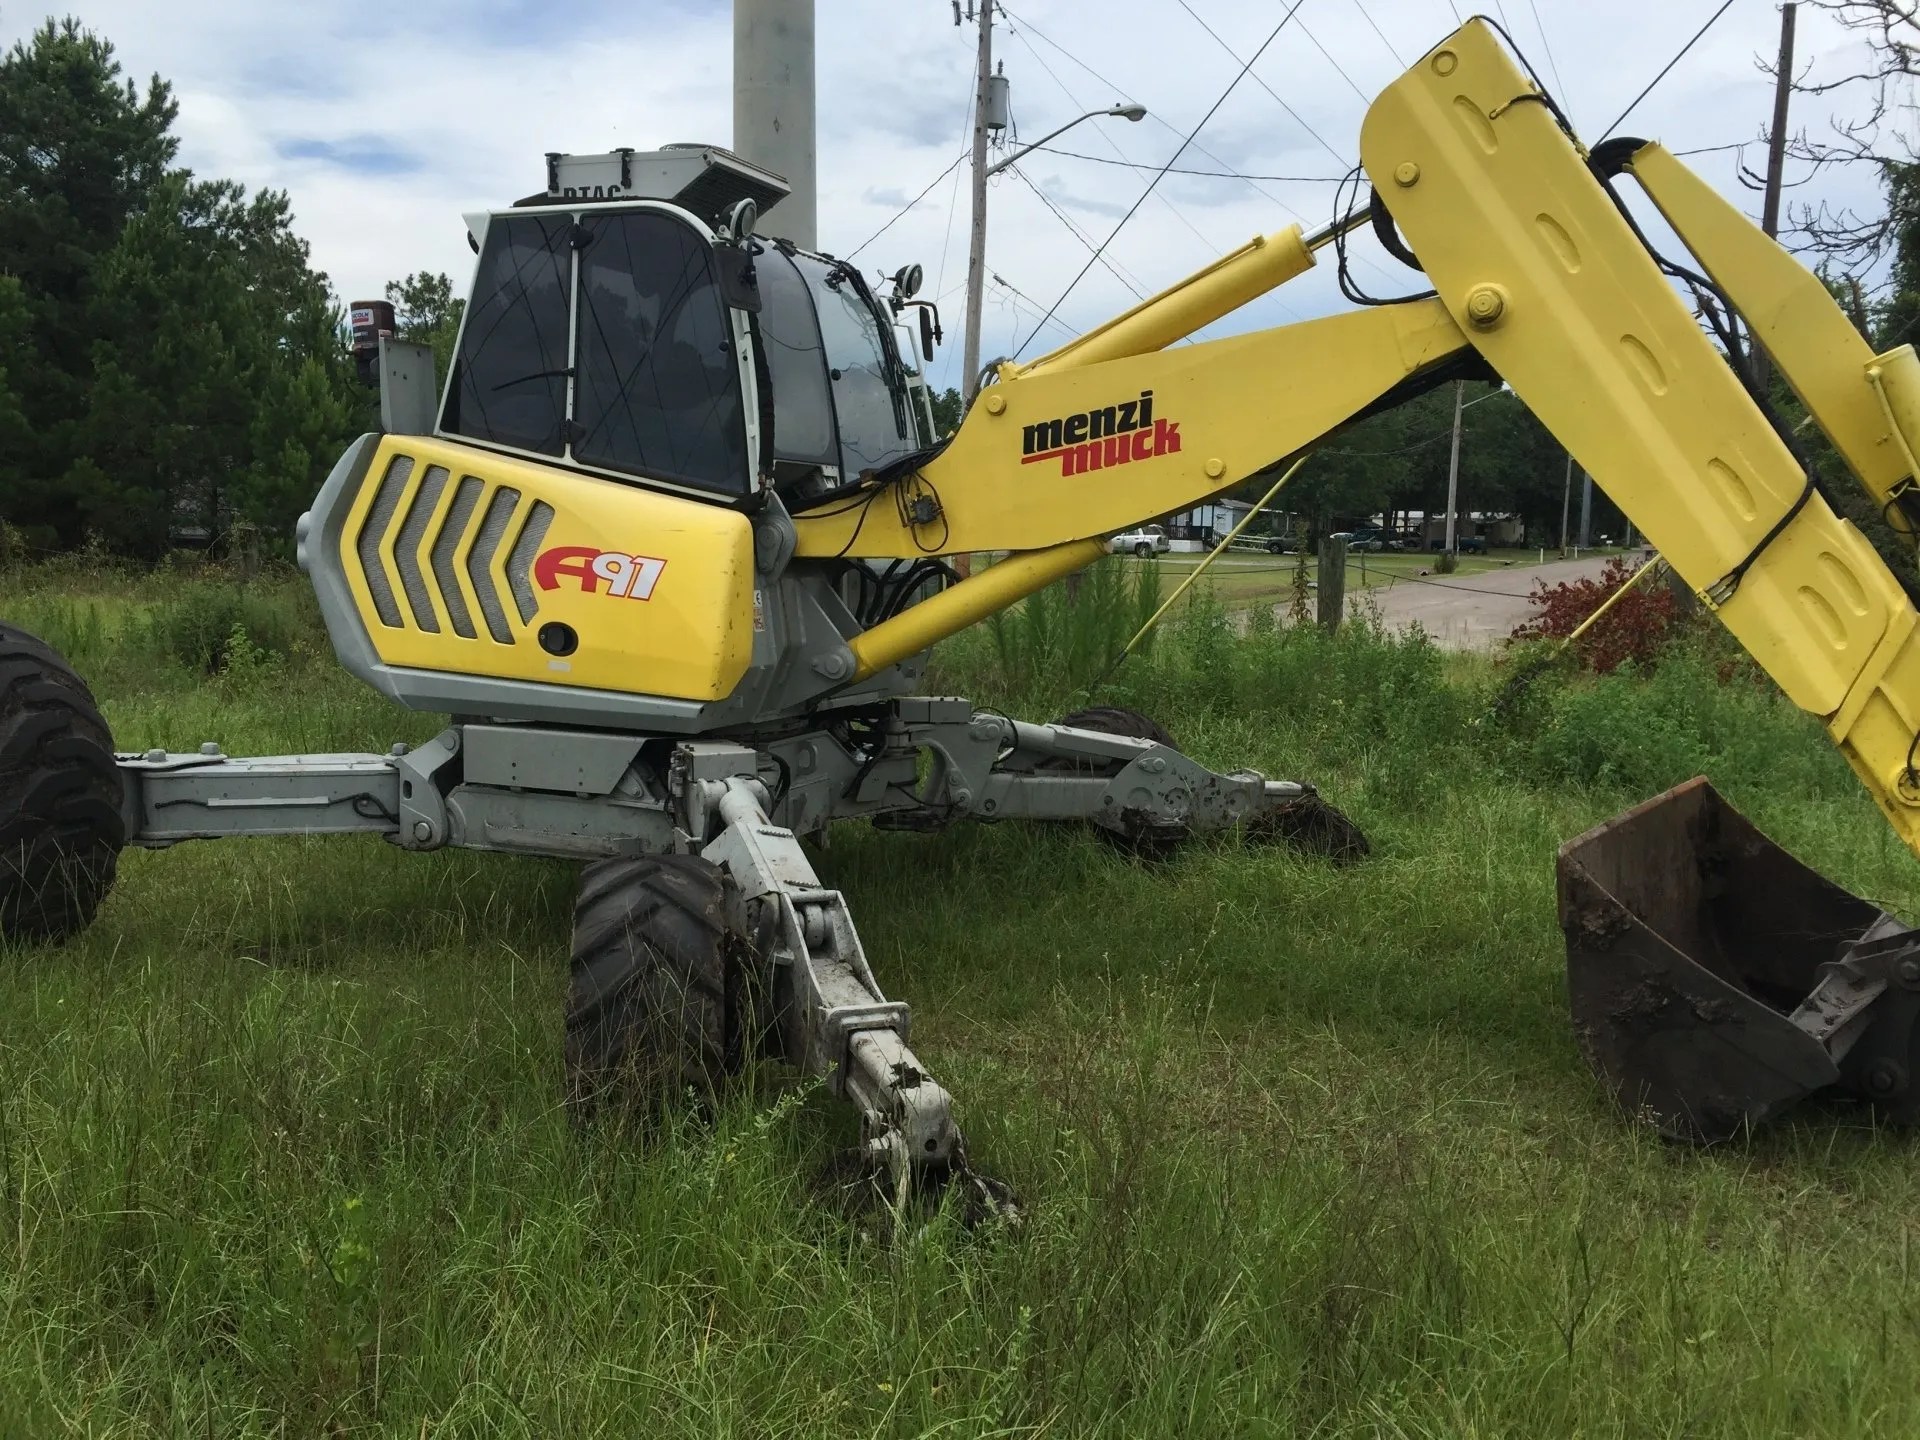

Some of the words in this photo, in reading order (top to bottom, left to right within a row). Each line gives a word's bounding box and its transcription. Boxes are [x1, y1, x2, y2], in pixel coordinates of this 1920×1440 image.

[1022, 389, 1154, 455] menzi
[1061, 418, 1182, 477] muck
[534, 546, 667, 601] A91
